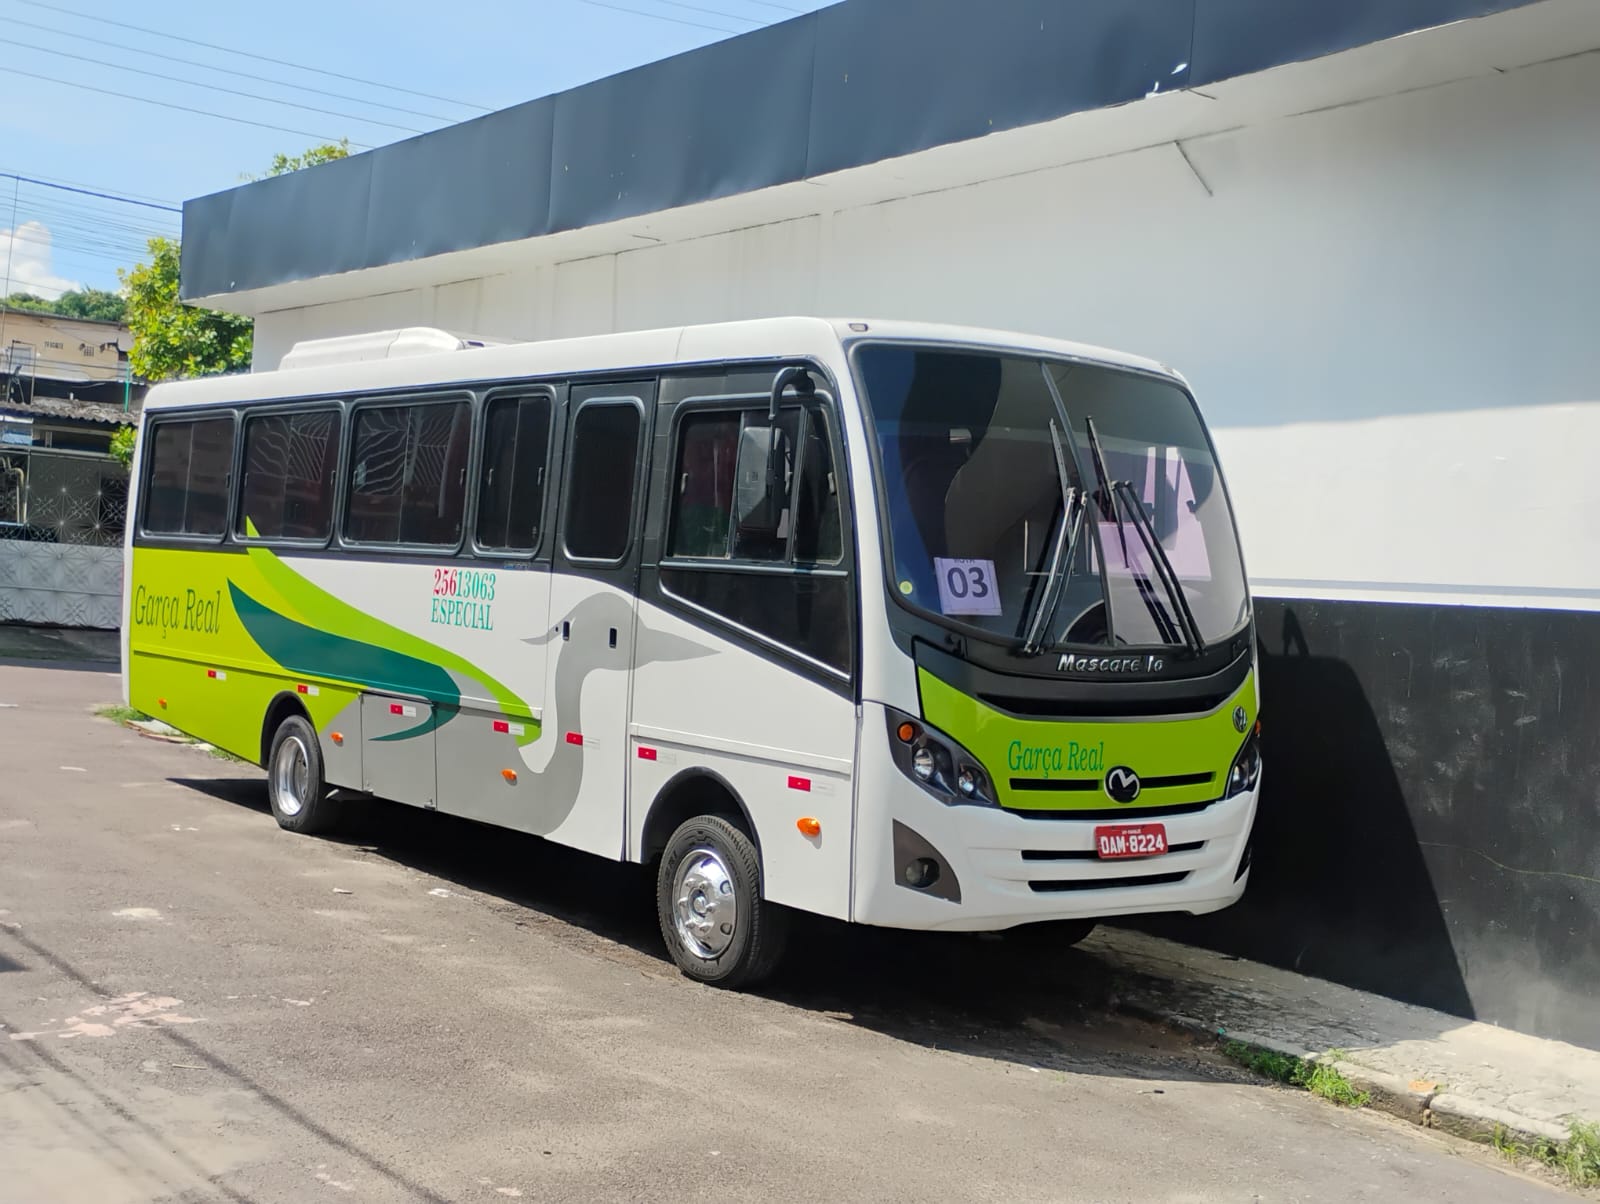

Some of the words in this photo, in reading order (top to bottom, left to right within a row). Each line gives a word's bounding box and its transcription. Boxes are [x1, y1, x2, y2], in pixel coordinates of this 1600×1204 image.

[433, 568, 496, 601] 25613063
[947, 566, 989, 598] 03
[134, 584, 180, 639] Garça
[183, 588, 221, 635] Real
[431, 597, 494, 631] ESPECIAL
[1008, 739, 1063, 779] Garça
[1067, 740, 1105, 772] Real
